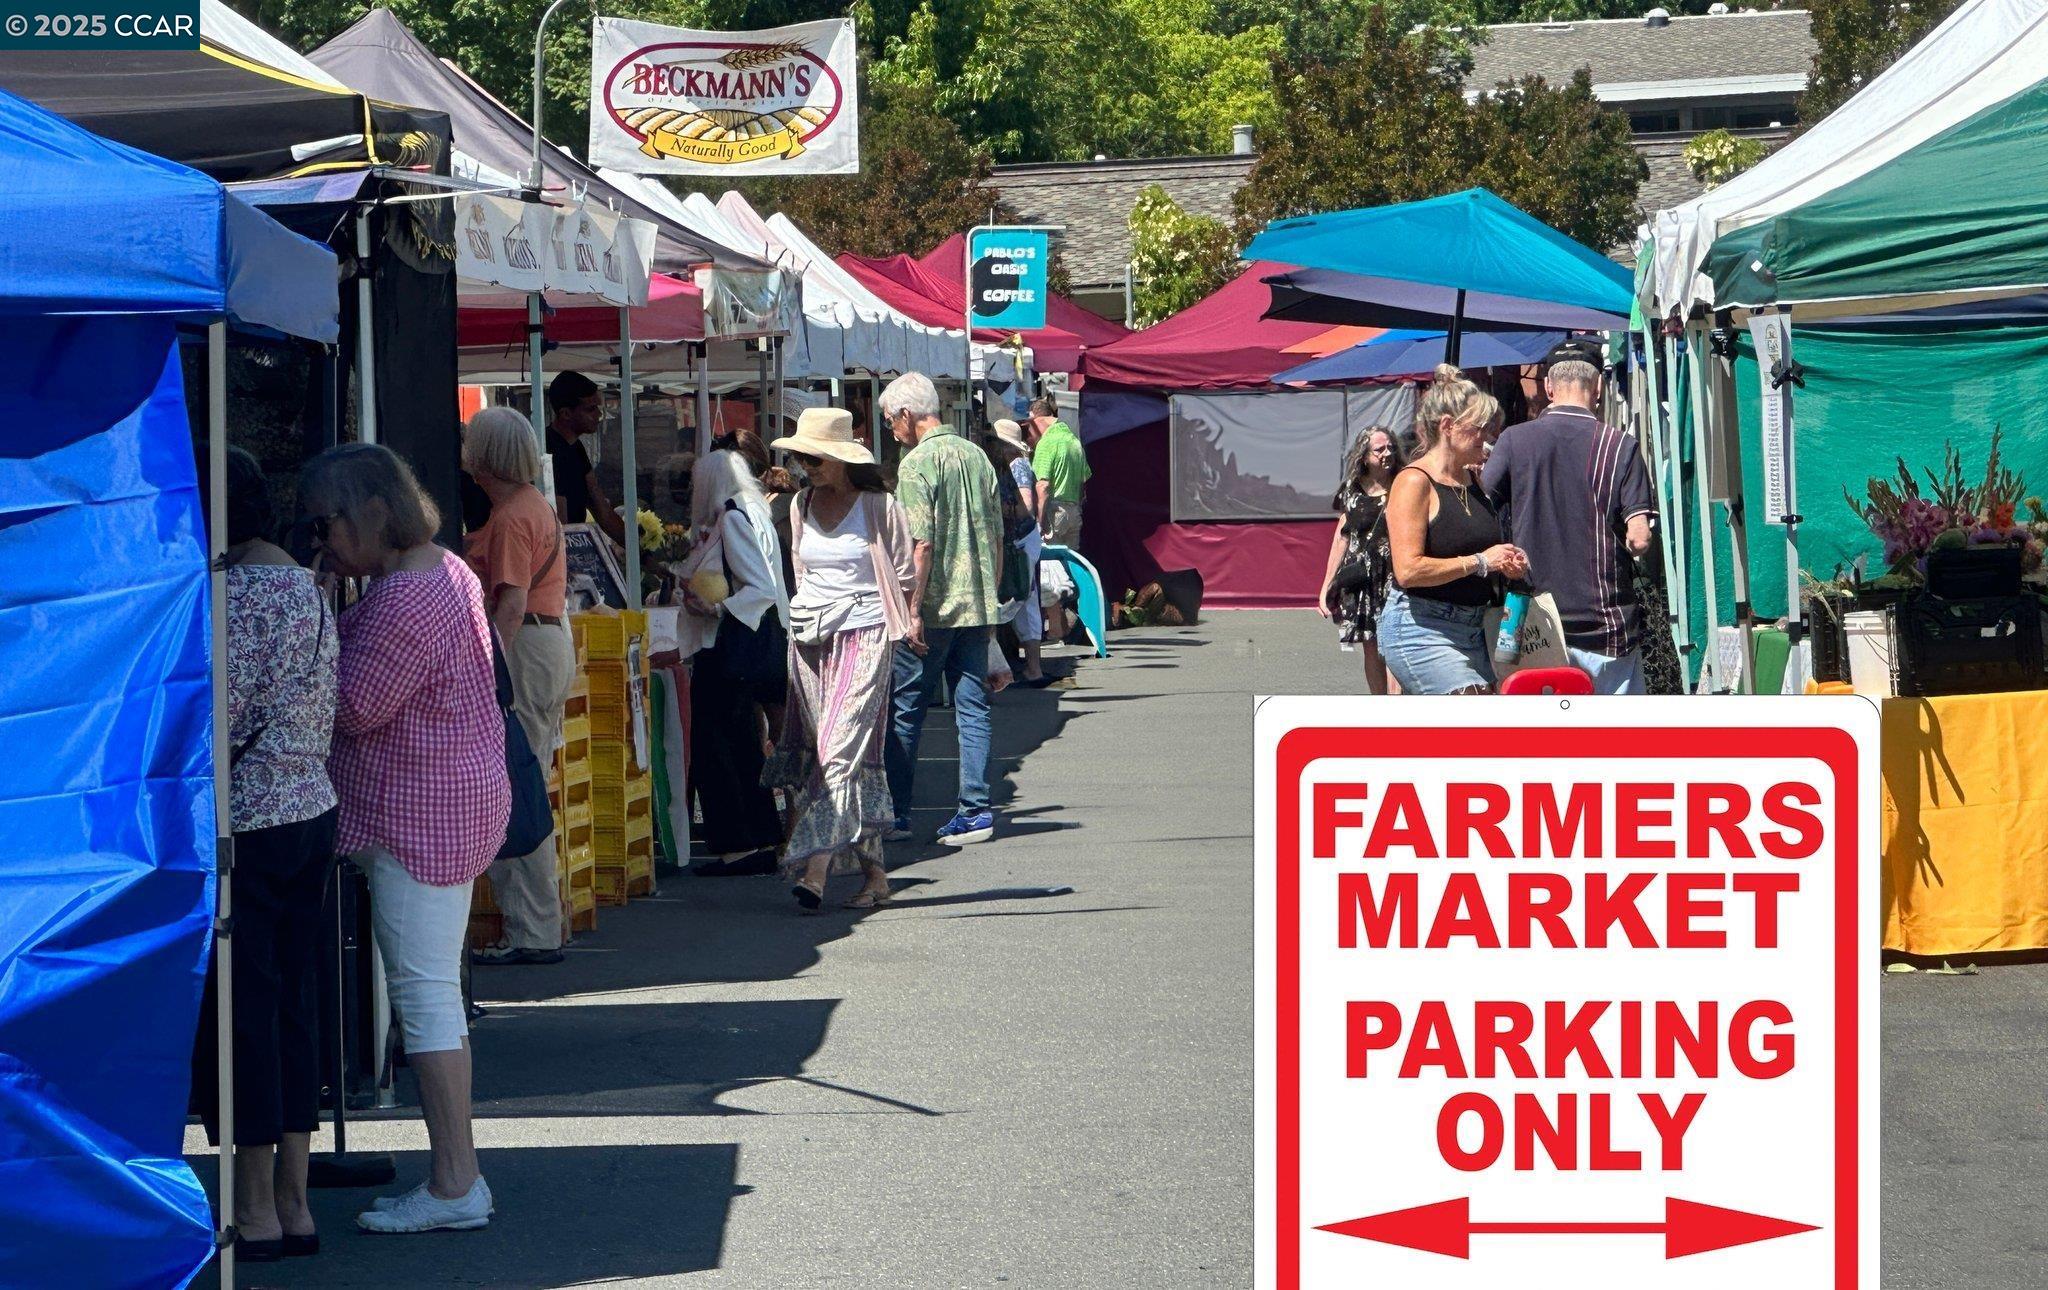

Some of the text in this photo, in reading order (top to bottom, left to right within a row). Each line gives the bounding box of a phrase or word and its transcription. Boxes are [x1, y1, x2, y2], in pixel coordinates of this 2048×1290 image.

[632, 62, 811, 100] BECKMANN'S
[670, 137, 776, 161] Naturally Good
[984, 247, 1036, 258] PABLO'S
[990, 263, 1028, 274] OASIS
[982, 289, 1036, 302] COFFEE
[1312, 781, 1825, 859] FARMERS
[1337, 872, 1800, 949] MARKET
[1346, 999, 1796, 1079] PARKING
[1436, 1091, 1708, 1172] ONLY
